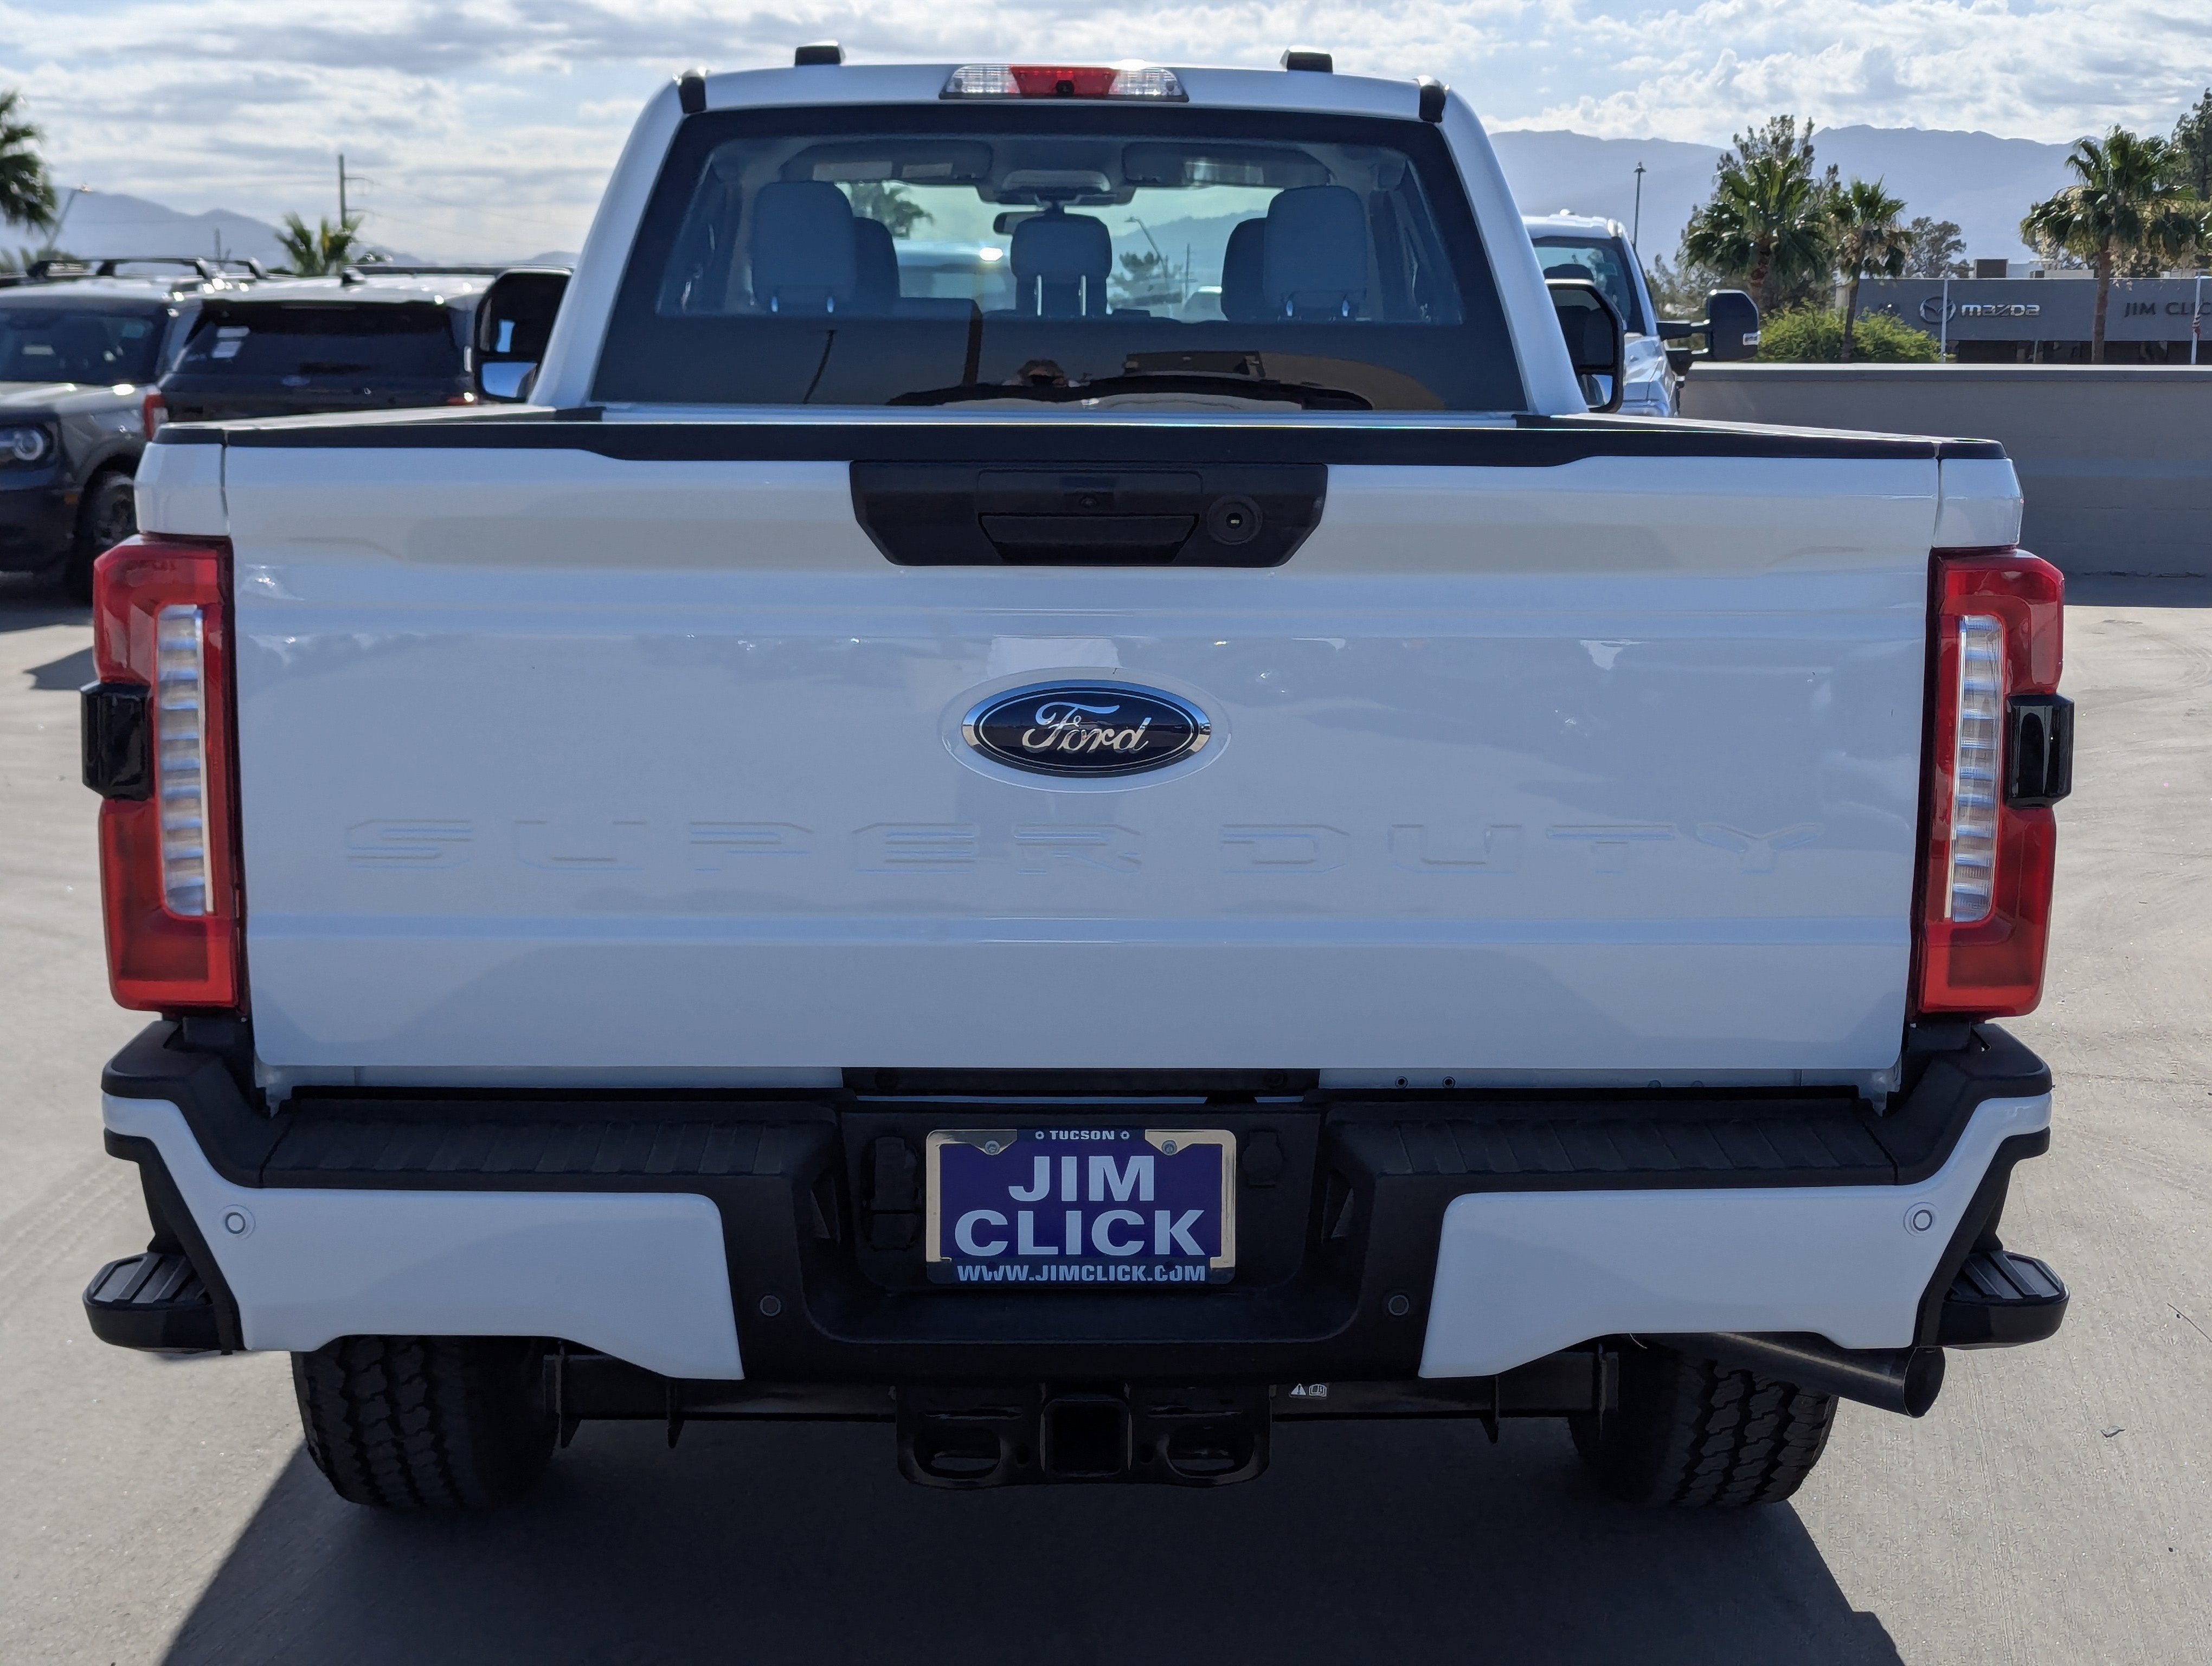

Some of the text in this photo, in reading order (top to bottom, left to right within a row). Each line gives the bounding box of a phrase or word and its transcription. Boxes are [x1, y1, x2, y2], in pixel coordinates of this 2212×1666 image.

[2124, 302, 2156, 317] JIM
[1022, 701, 1152, 754] Ford
[343, 818, 1827, 874] SUPER DUTY
[1050, 1130, 1115, 1140] TUCSON
[1008, 1155, 1155, 1202] JIM
[954, 1209, 1205, 1256] CLICK
[957, 1265, 1205, 1282] WWW.JIMCLICK.COM
